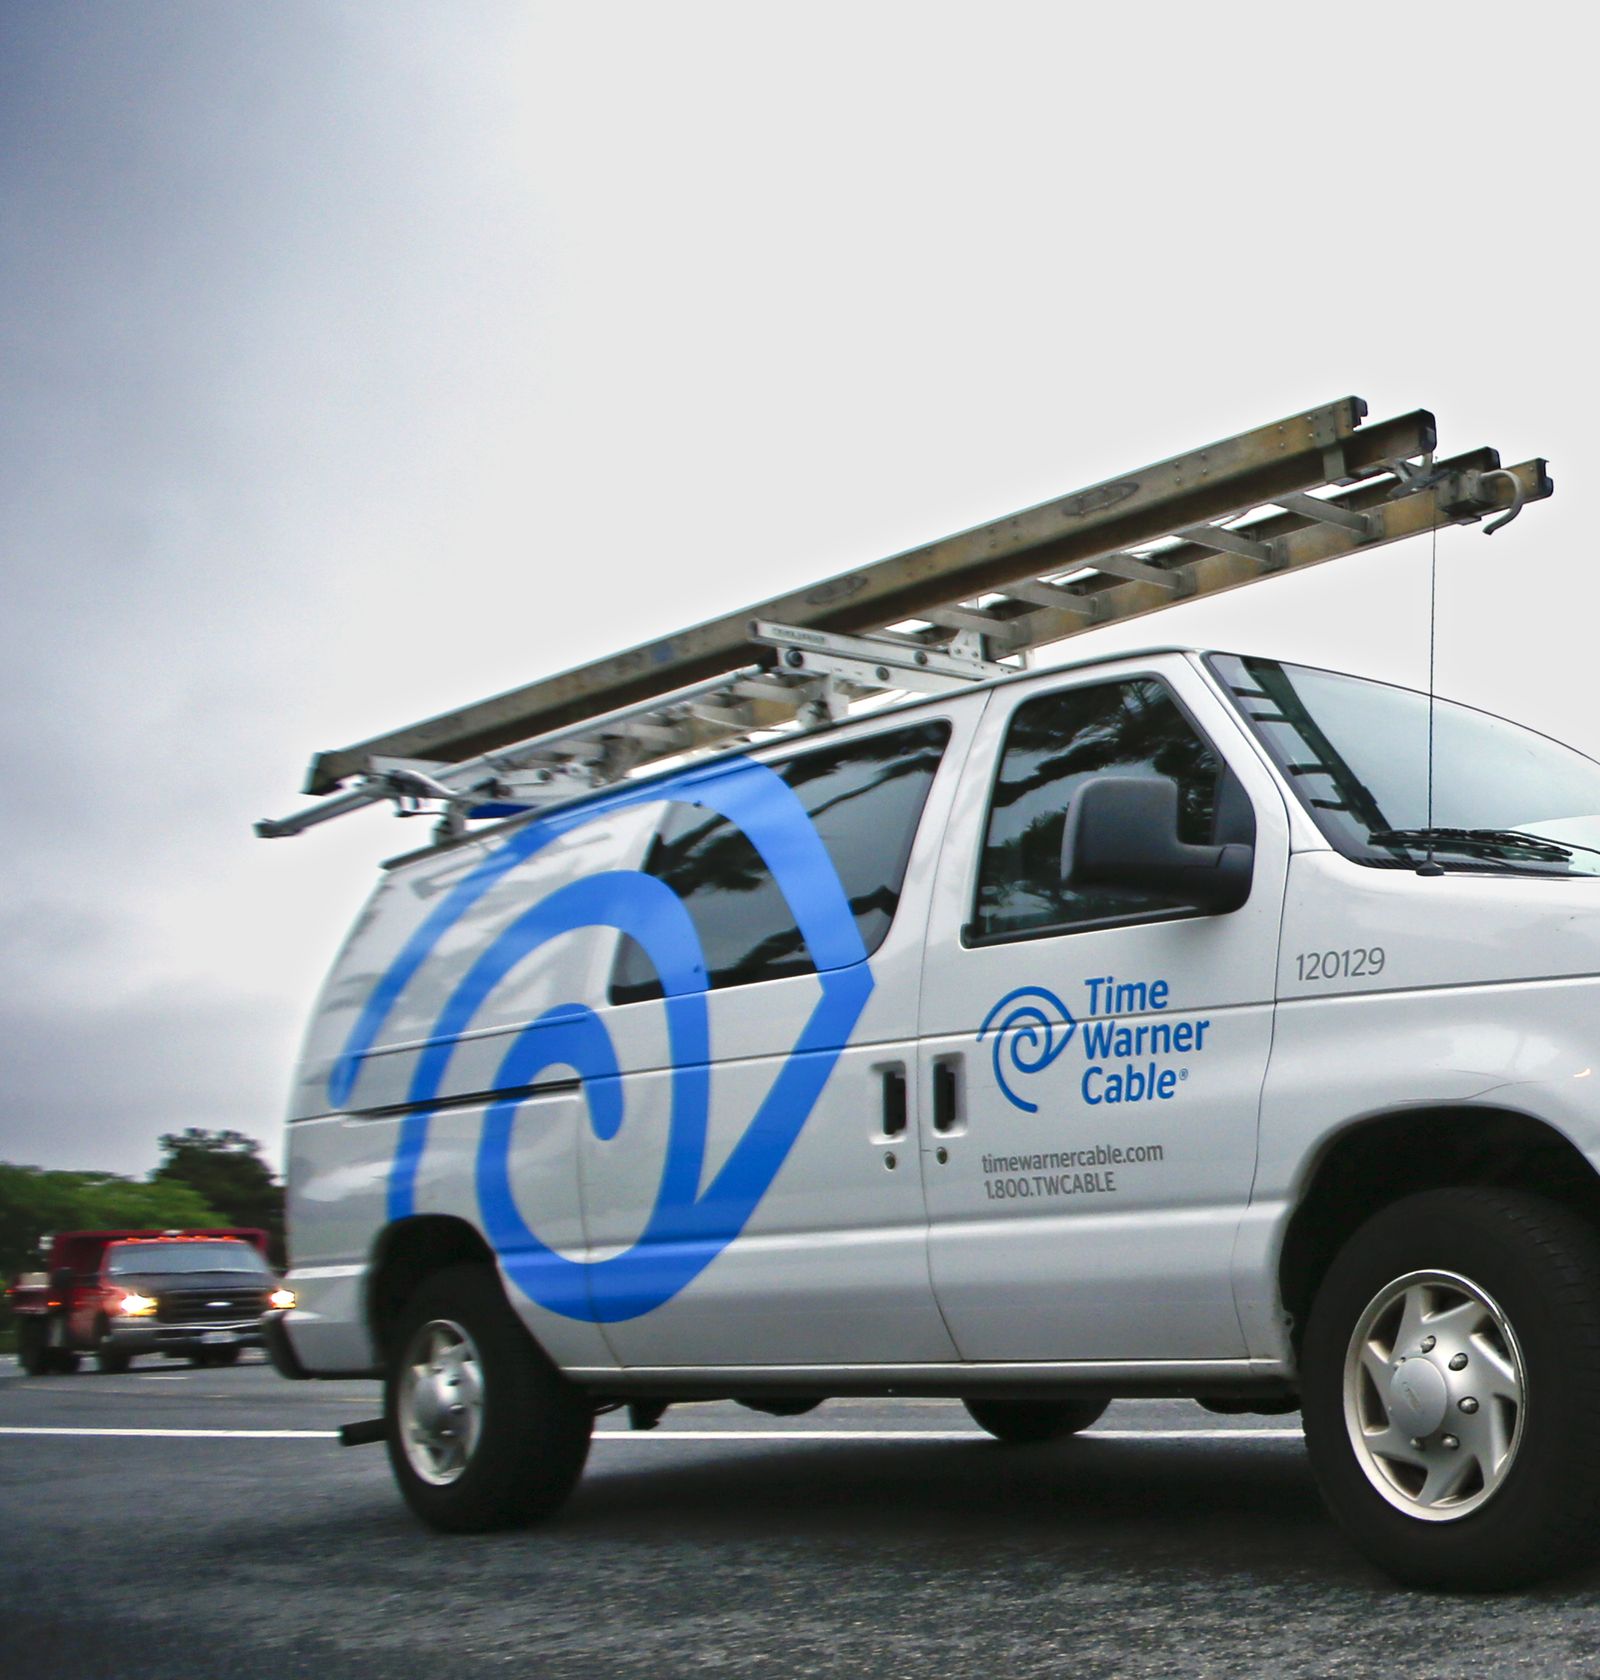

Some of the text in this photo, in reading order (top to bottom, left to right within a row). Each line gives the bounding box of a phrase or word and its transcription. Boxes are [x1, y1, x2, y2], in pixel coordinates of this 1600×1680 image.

[1296, 947, 1386, 981] 120129
[1084, 976, 1169, 1016] Time
[1082, 1020, 1210, 1060] Warner
[982, 1144, 1164, 1174] timewarnercable.com
[984, 1171, 1117, 1200] 1.800.TWCABLE
